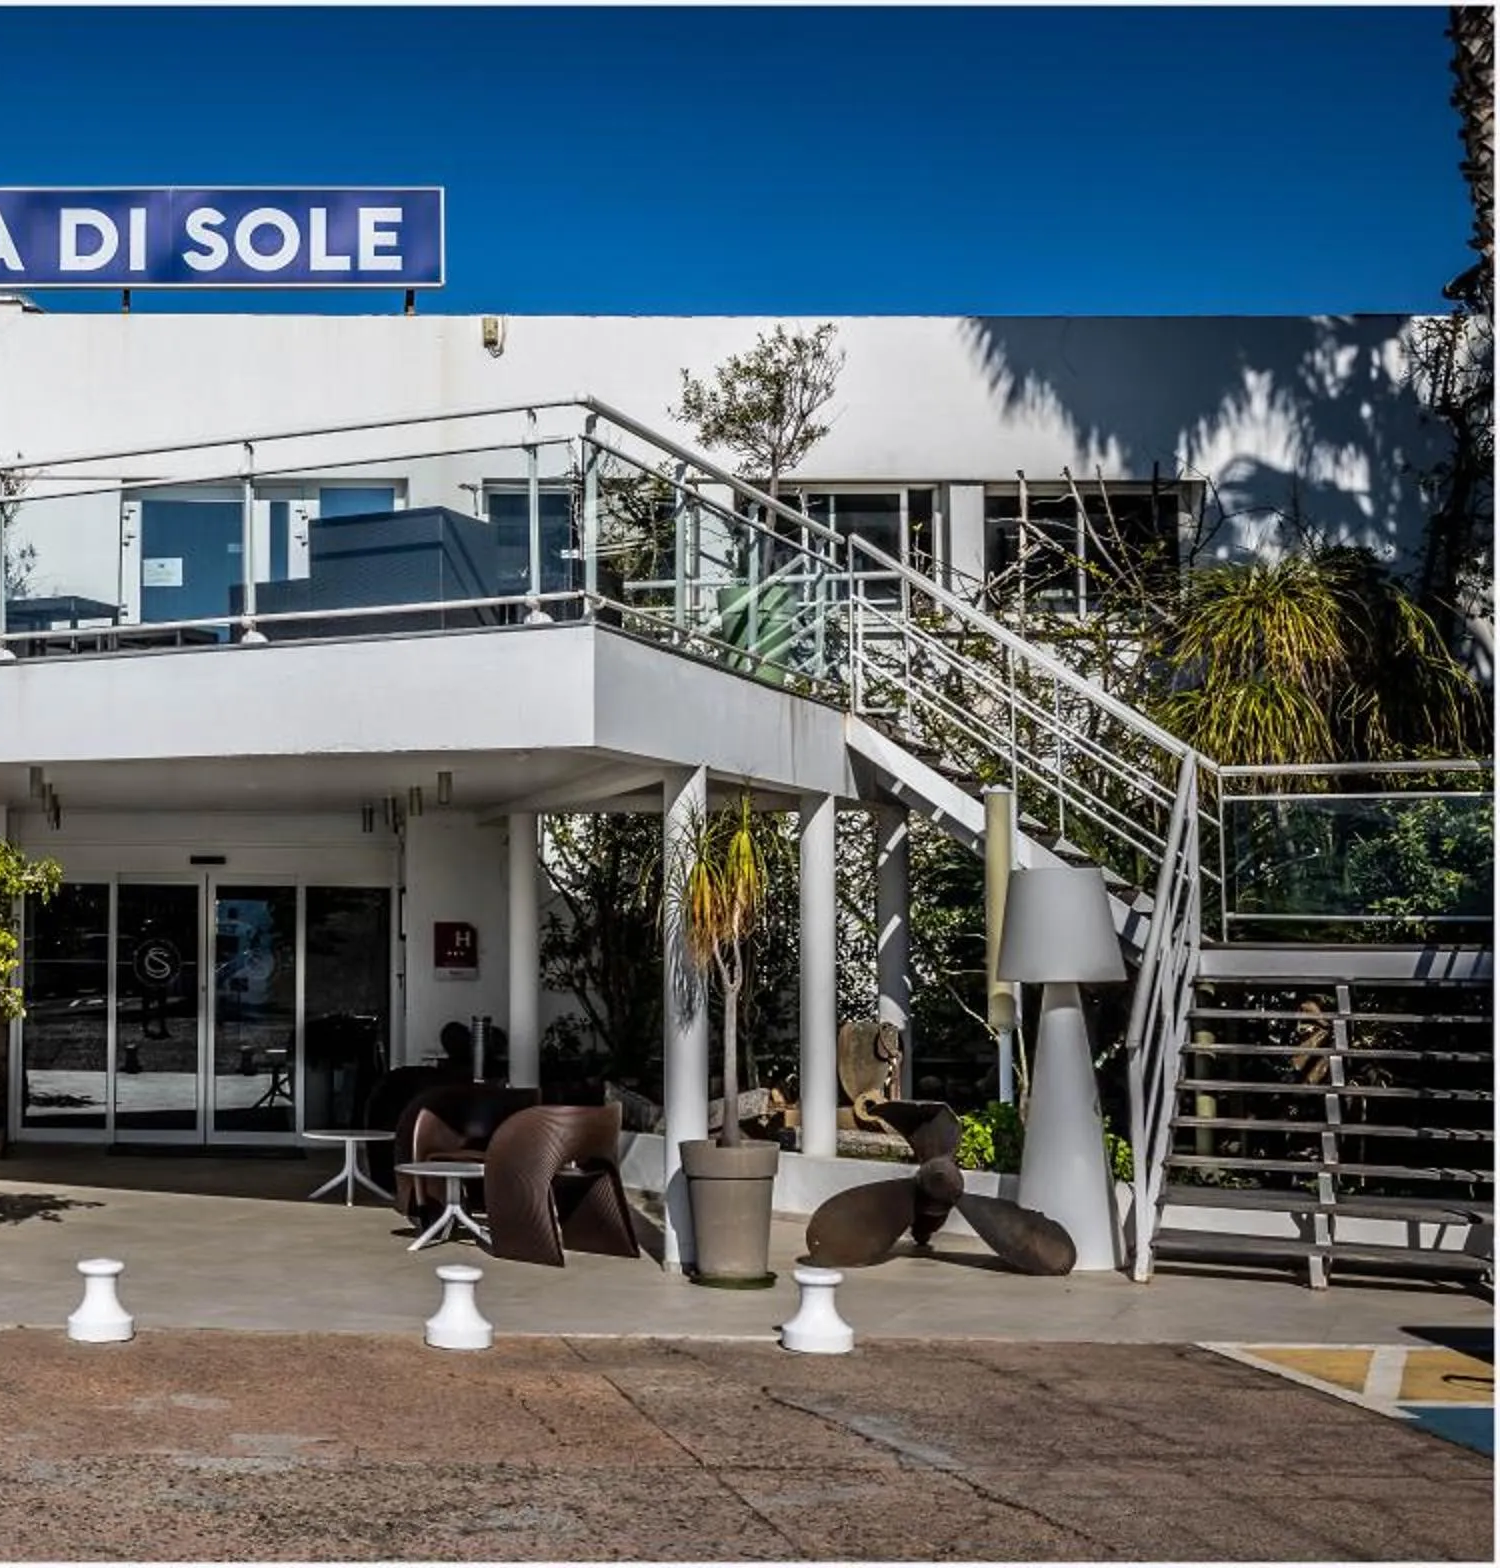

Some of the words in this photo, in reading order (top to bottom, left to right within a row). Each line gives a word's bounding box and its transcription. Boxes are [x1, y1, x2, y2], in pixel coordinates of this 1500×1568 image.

[59, 208, 147, 271] DI
[183, 208, 403, 272] SOLE
[455, 930, 471, 947] H
